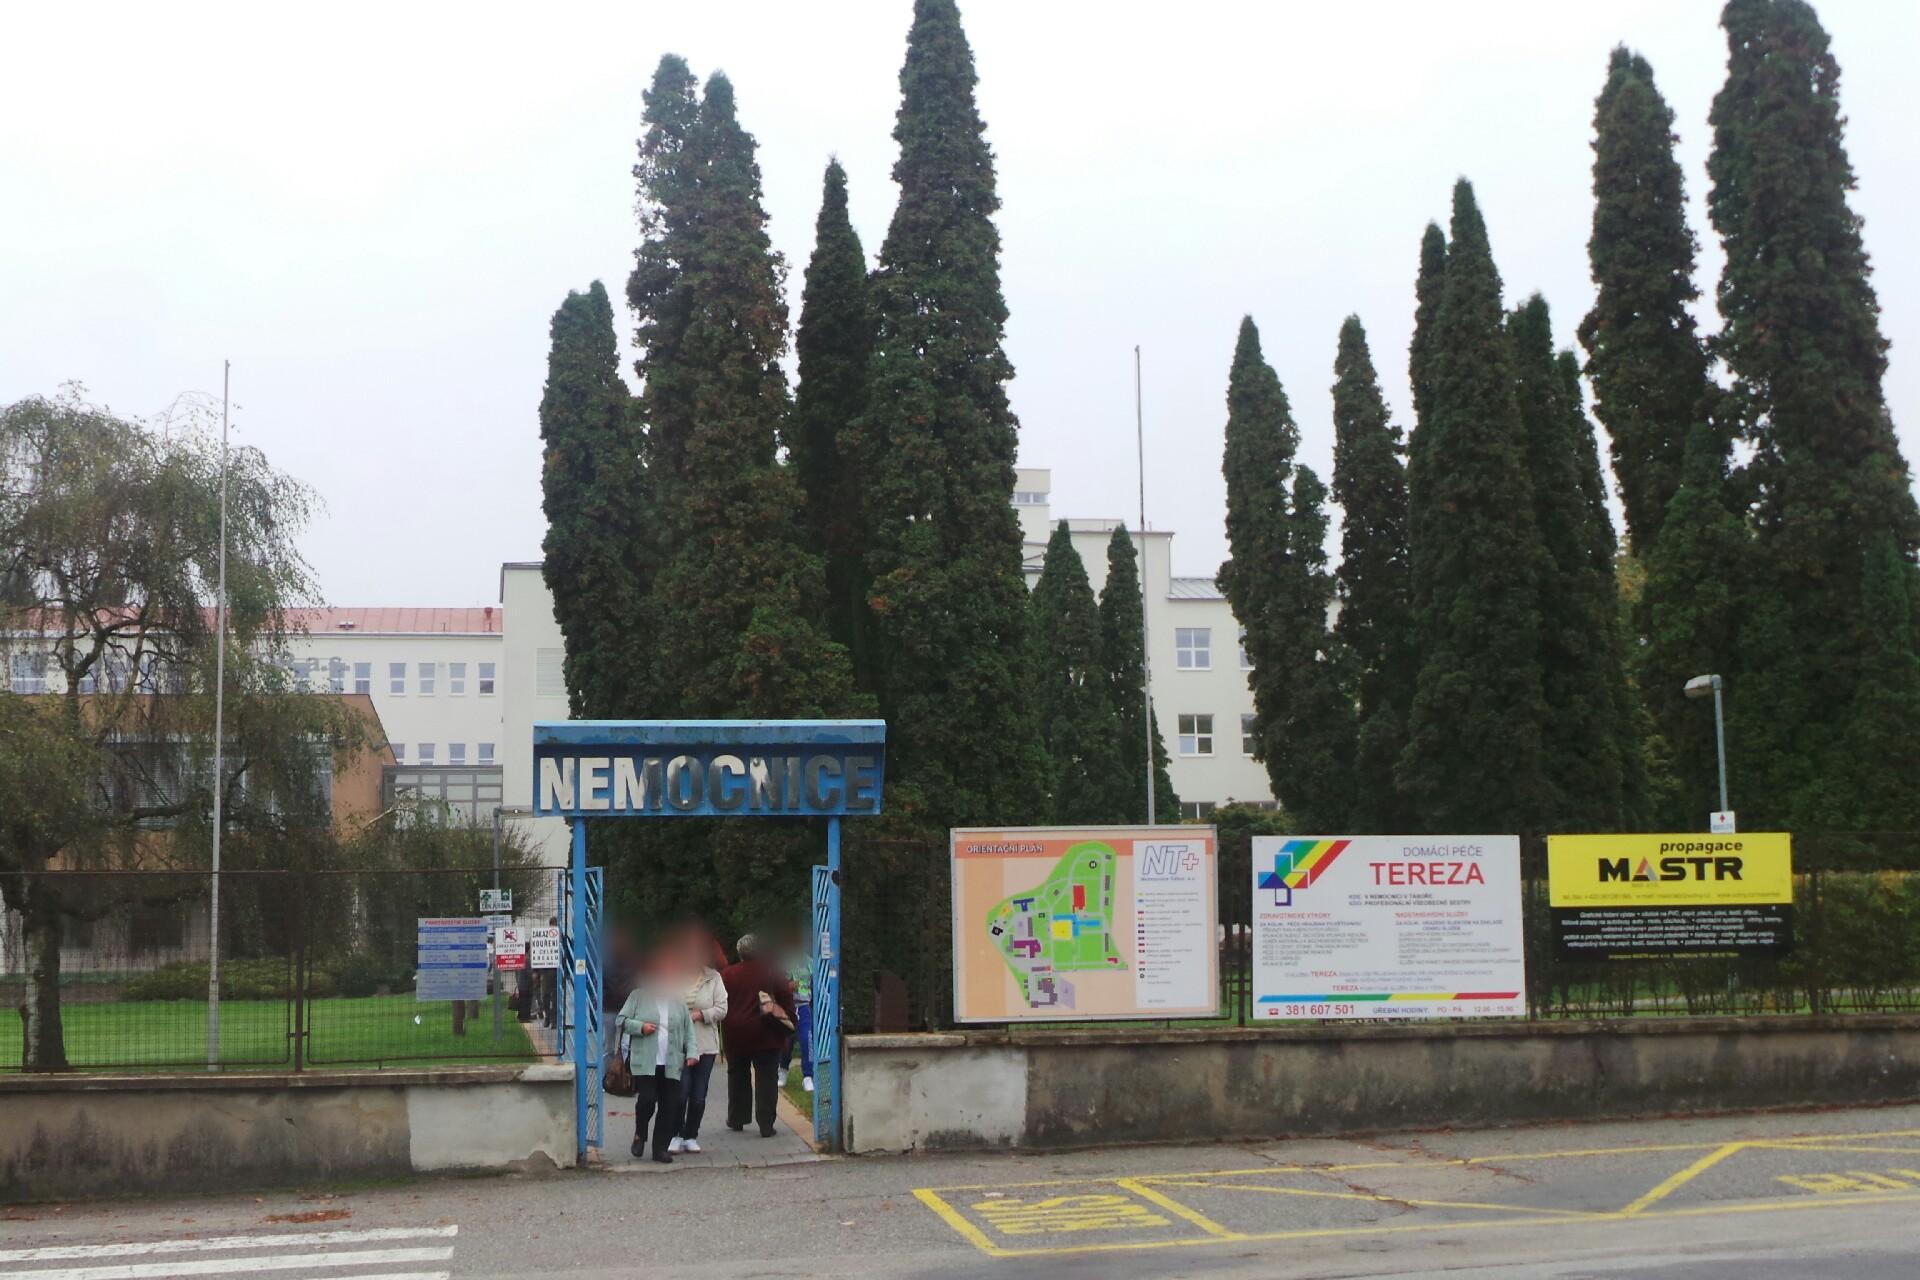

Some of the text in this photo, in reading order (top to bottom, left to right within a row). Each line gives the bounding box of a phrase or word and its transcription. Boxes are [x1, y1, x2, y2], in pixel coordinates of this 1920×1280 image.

[540, 755, 876, 811] NEMOCNICE
[1403, 845, 1483, 857] DOMÁCÍ PÉČE
[1659, 841, 1743, 854] propagace
[1369, 862, 1485, 885] TEREZA
[1598, 856, 1743, 882] MASTR
[1286, 1004, 1355, 1015] 381 607 501
